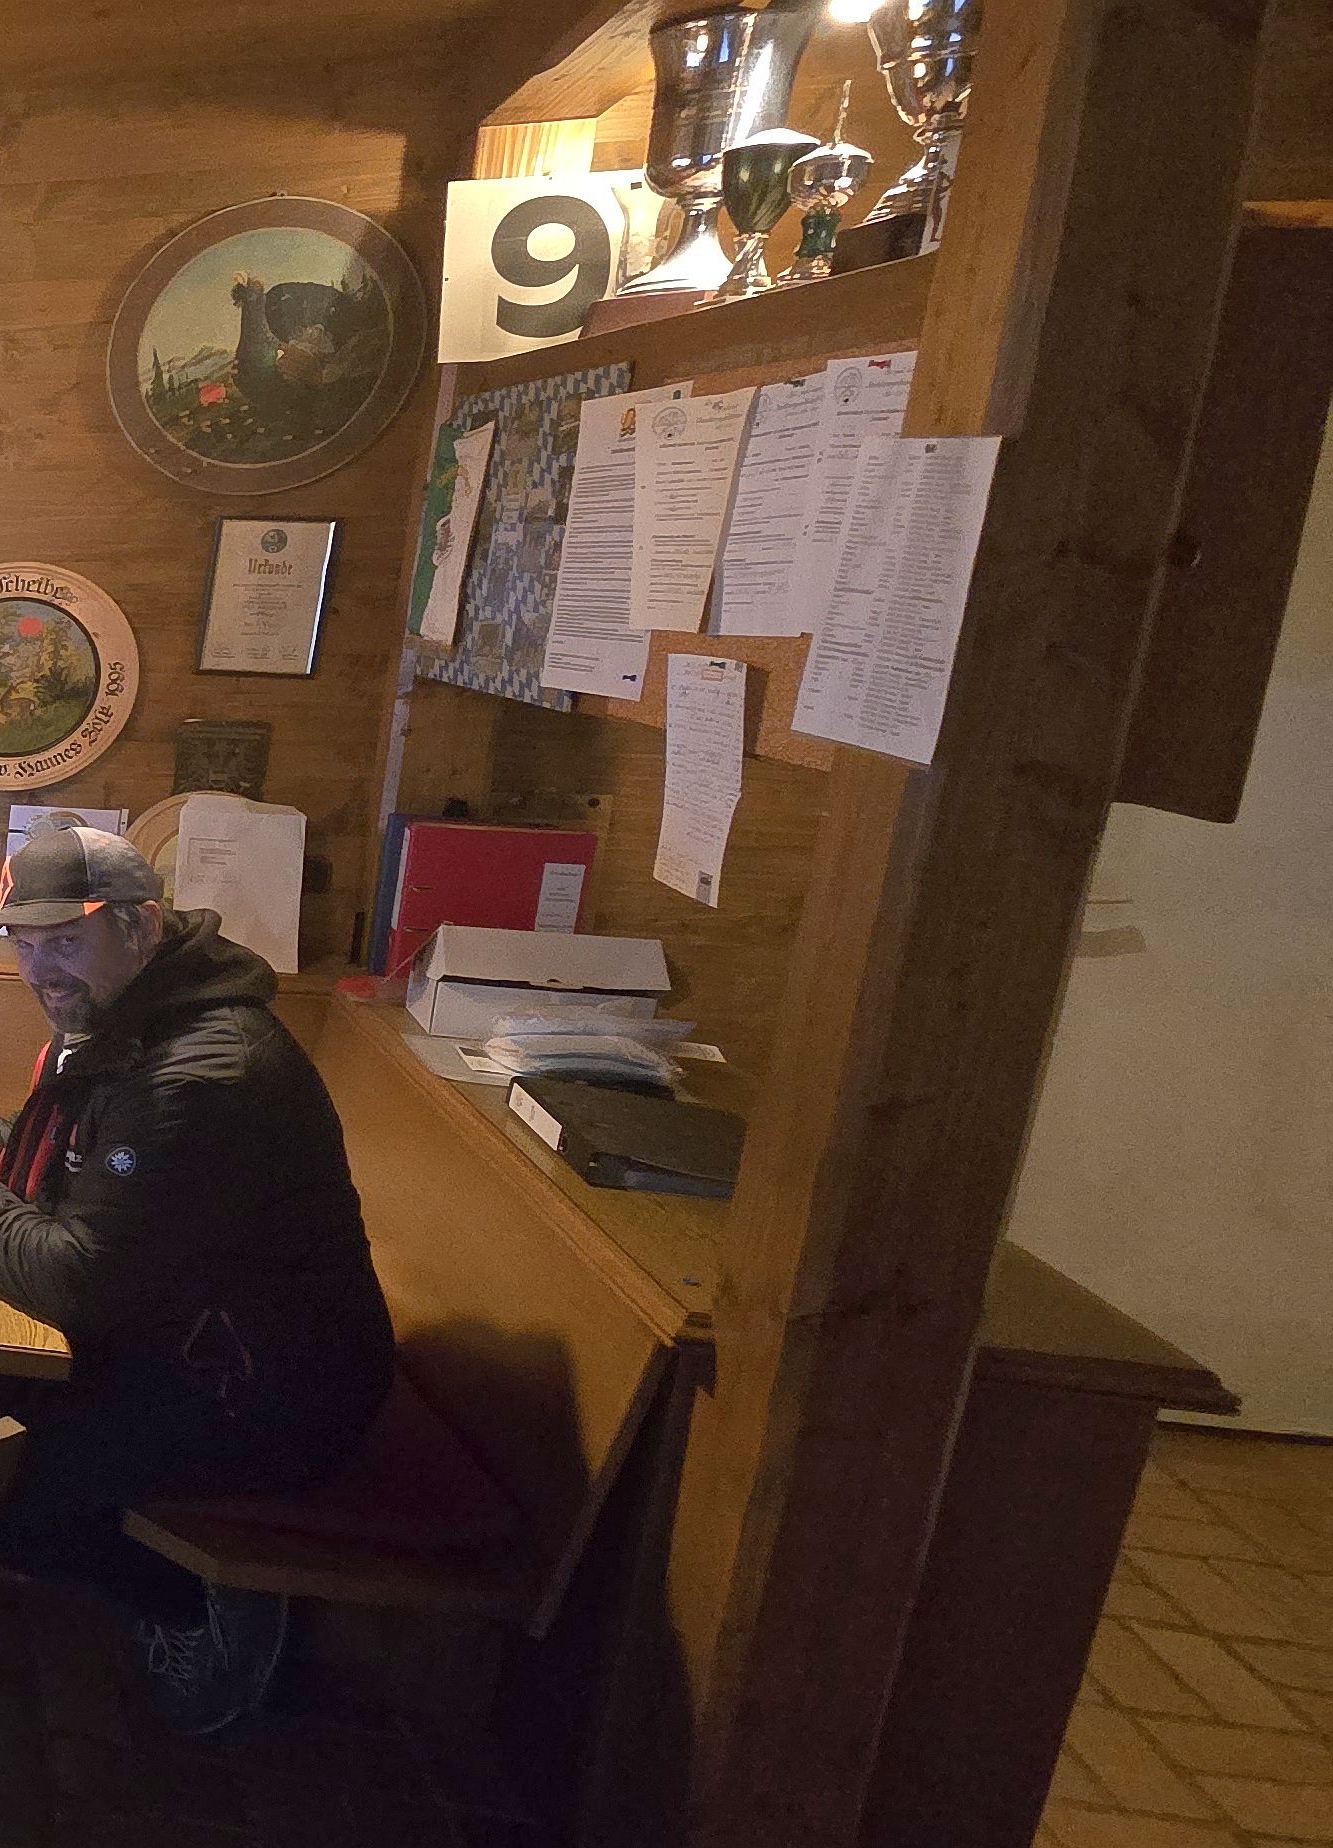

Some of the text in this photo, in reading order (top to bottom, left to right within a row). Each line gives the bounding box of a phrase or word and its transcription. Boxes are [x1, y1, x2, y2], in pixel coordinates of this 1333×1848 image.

[491, 195, 611, 338] 9
[13, 739, 84, 780] Hannes
[105, 661, 126, 698] 1995
